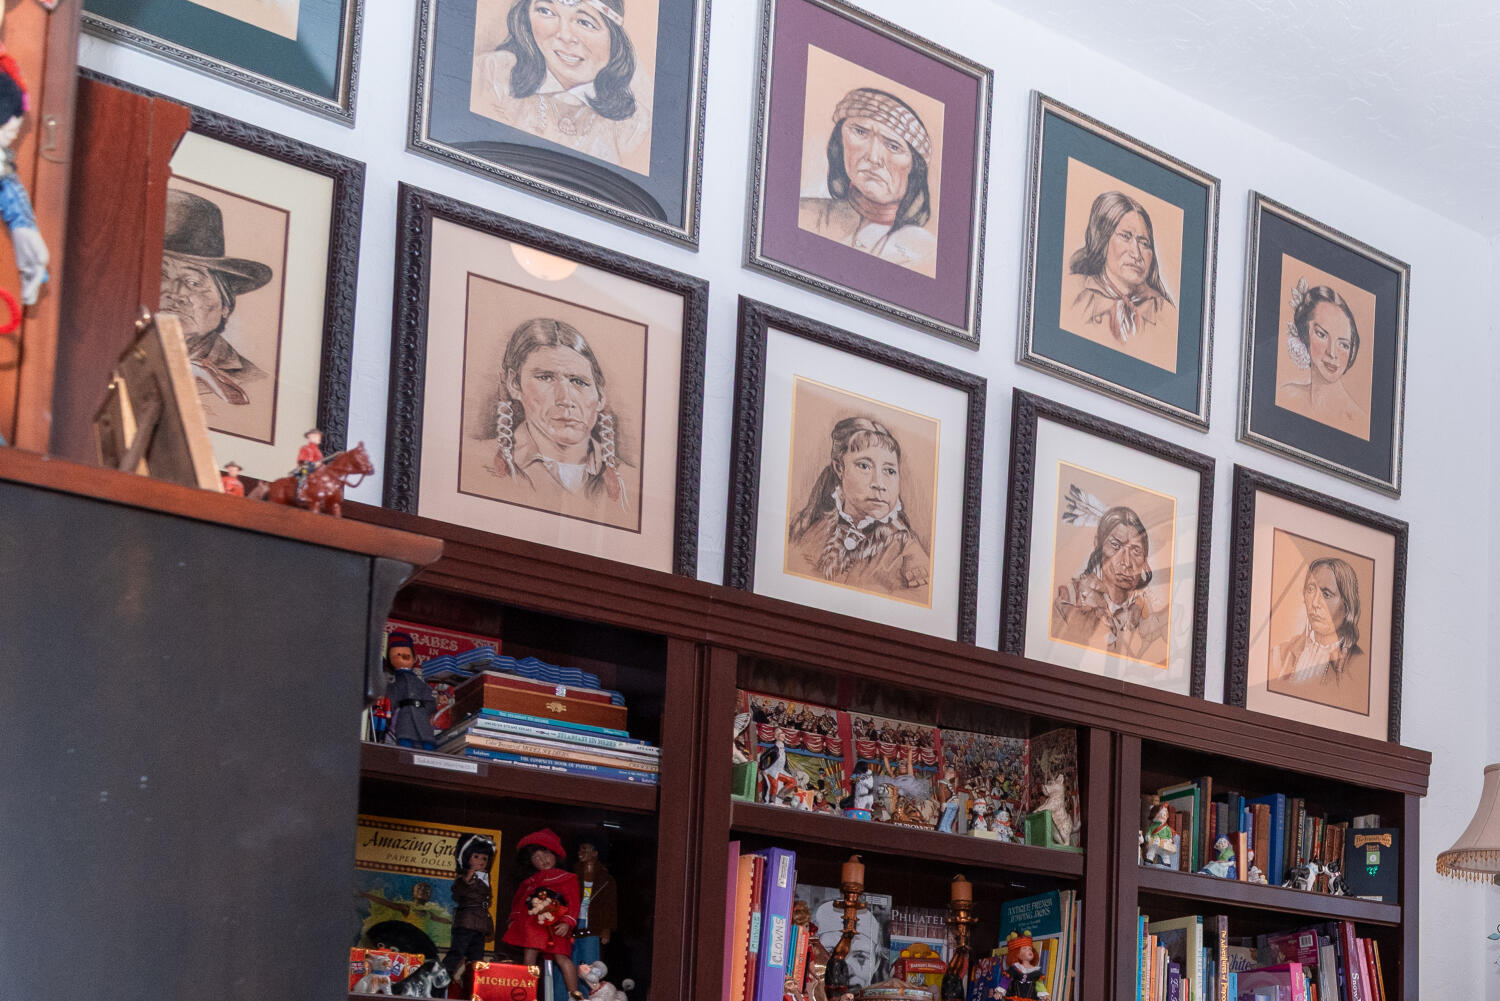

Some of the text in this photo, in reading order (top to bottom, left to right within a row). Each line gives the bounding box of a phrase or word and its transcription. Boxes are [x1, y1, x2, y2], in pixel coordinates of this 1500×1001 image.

[410, 633, 458, 651] BABES
[363, 832, 456, 859] Amazing Gra
[385, 853, 452, 866] PAPER DOLLS
[891, 909, 946, 925] PHILATEL
[772, 918, 784, 963] CLOWNS
[1220, 939, 1228, 974] Adventures
[476, 975, 536, 988] MICHIGAN
[1351, 972, 1361, 998] Snow
